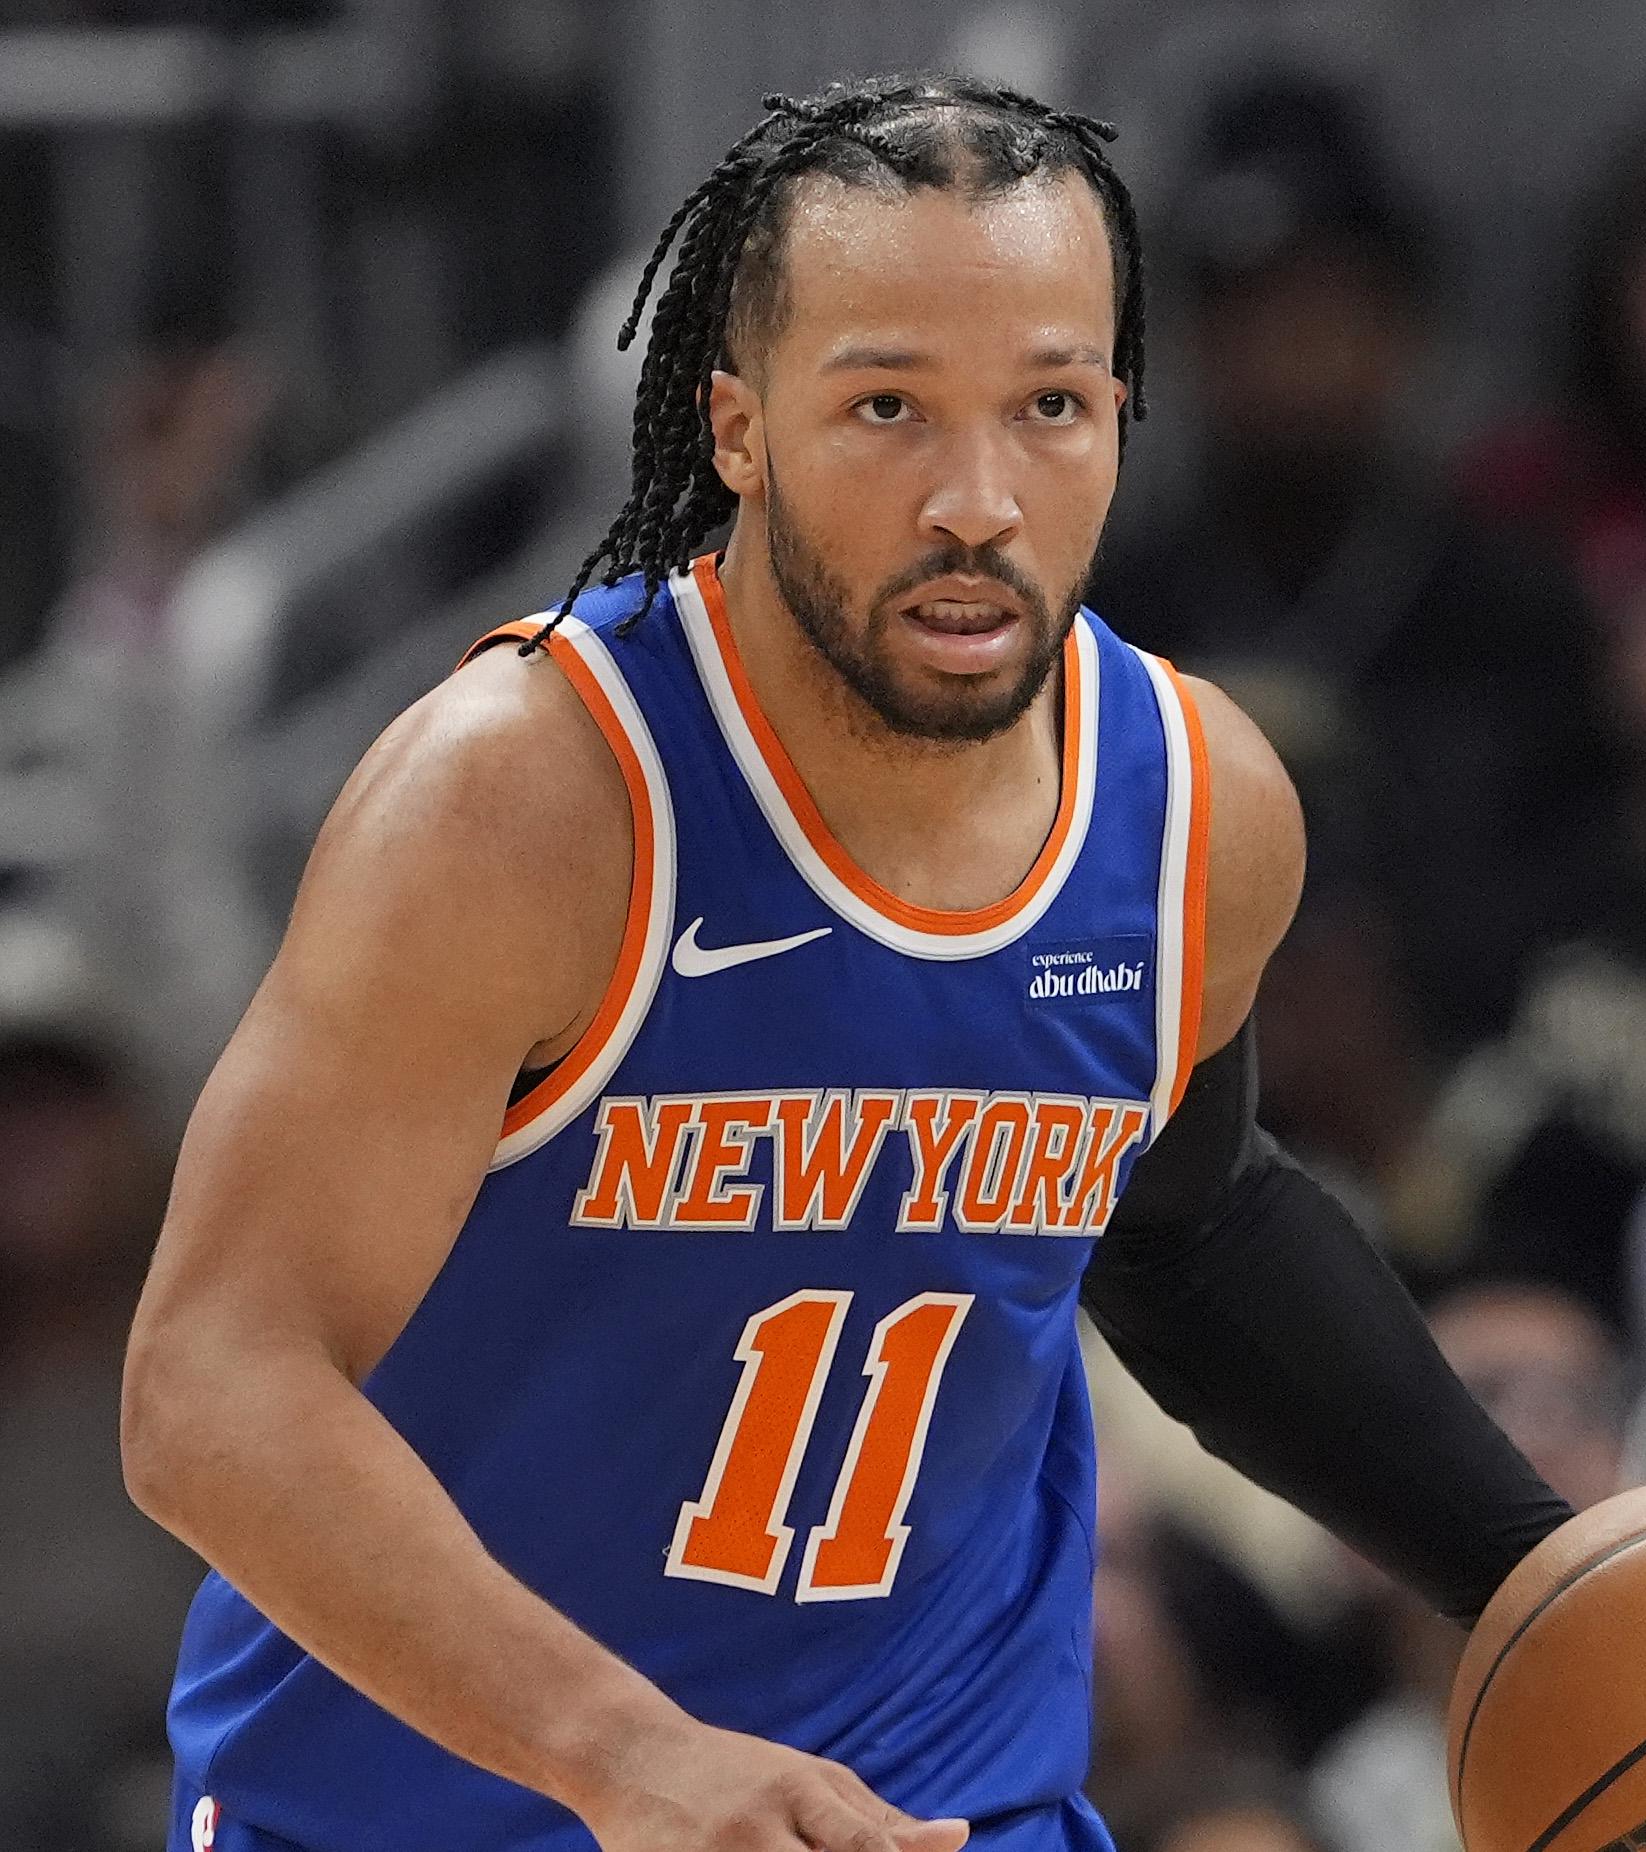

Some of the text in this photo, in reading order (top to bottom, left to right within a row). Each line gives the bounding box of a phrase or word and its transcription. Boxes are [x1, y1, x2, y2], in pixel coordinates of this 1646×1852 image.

[1029, 961, 1145, 999] abu dhabi
[1032, 951, 1094, 969] experience
[569, 1088, 1151, 1237] NEW YORK
[664, 1288, 976, 1605] 11
